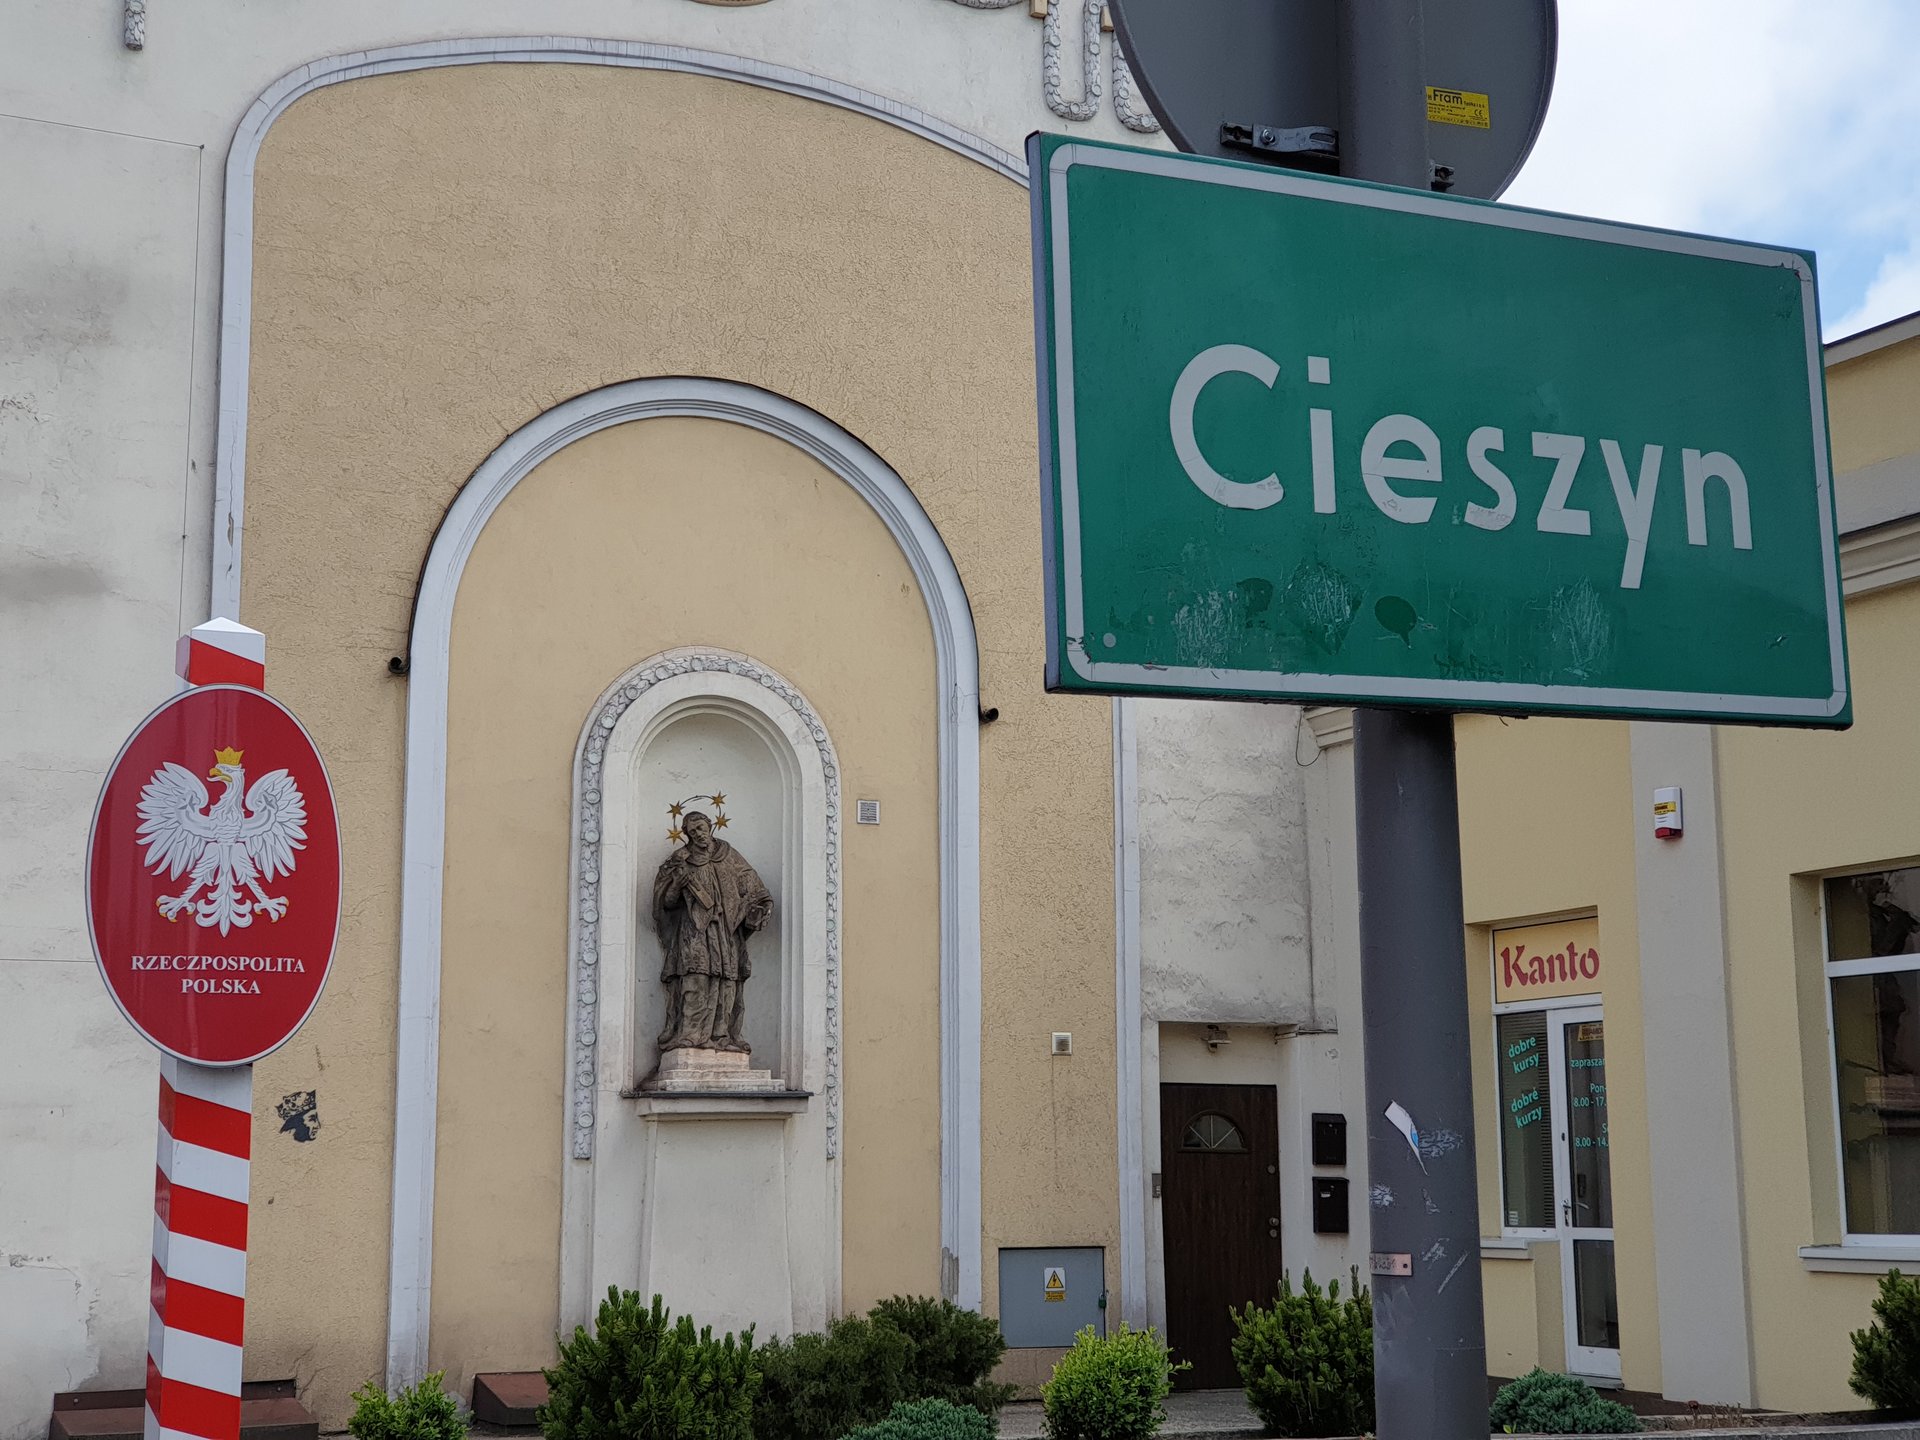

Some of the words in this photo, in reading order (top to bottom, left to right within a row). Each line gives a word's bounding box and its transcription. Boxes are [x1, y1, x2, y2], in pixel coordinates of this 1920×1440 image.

[1433, 89, 1463, 104] Fram
[1170, 343, 1753, 589] Cieszyn
[131, 955, 305, 973] RZECZPOSPOLITA
[181, 979, 261, 995] POLSKA
[1508, 1036, 1537, 1058] dobre
[1513, 1053, 1539, 1074] kursy
[1573, 1096, 1590, 1107] 8.00
[1515, 1106, 1542, 1129] kurzy
[1575, 1137, 1592, 1148] 8.00
